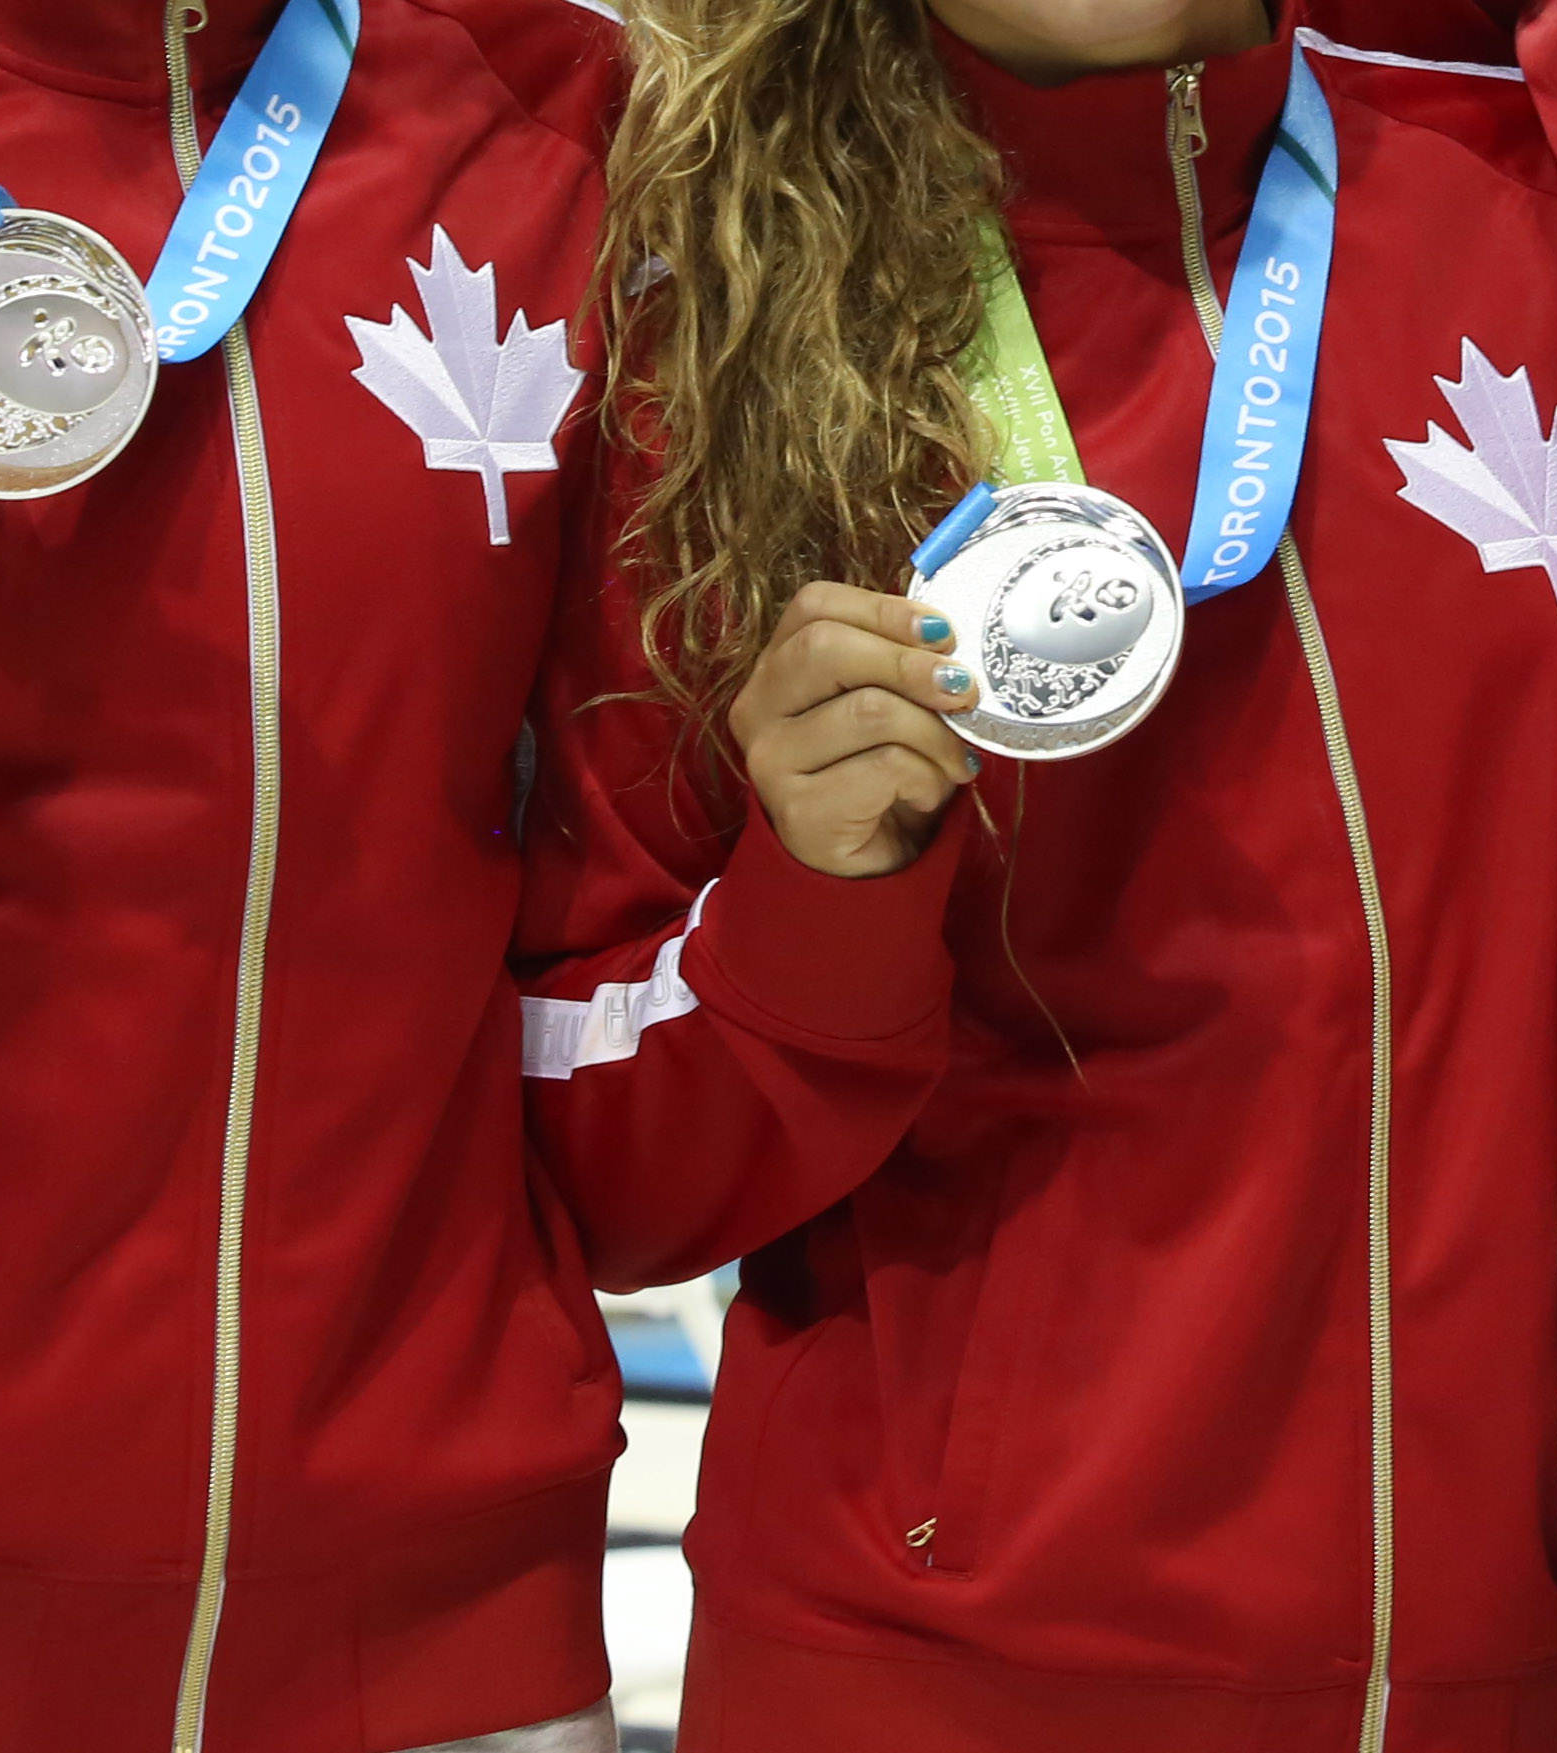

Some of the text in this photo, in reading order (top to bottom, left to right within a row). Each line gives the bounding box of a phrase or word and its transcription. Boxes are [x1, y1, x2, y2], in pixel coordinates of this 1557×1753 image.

[1019, 363, 1049, 406] XVII
[1035, 410, 1059, 448] Pan
[1011, 433, 1039, 480] Jeux
